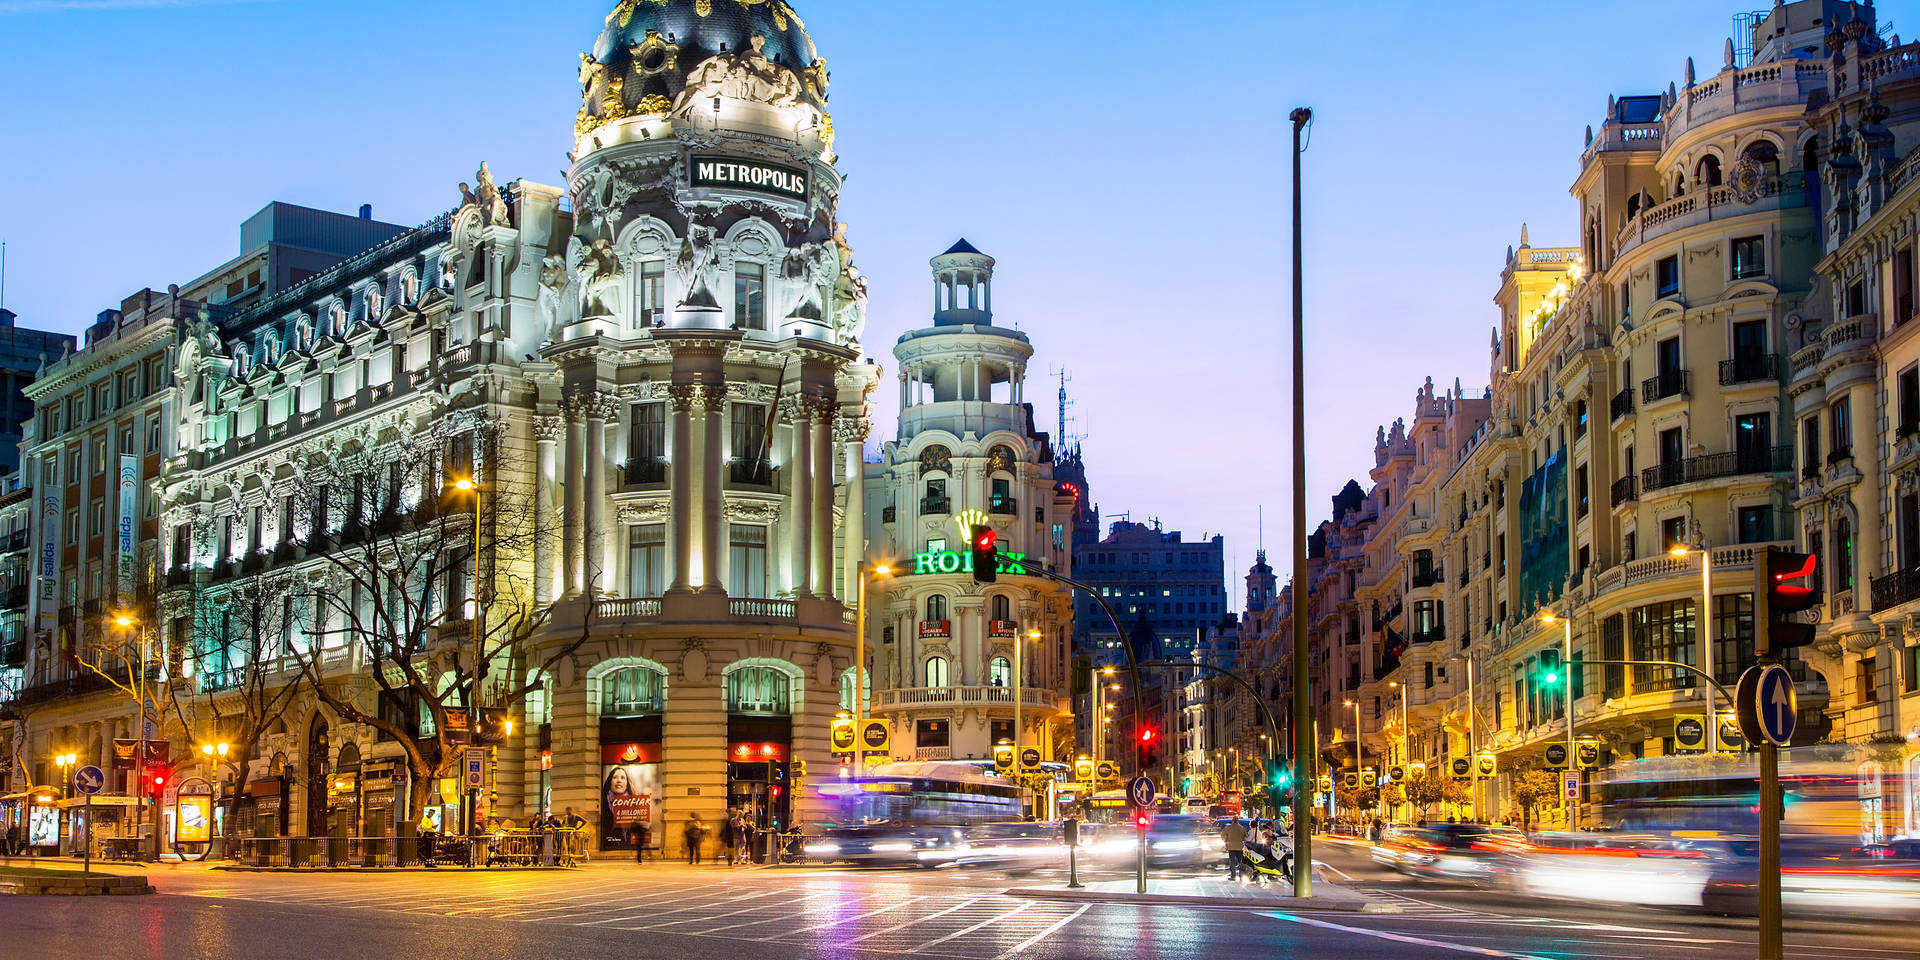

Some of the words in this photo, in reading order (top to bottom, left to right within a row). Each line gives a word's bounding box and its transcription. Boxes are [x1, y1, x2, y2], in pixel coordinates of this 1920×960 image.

[698, 162, 805, 194] METROPOLIS
[119, 516, 131, 553] salida
[42, 542, 55, 577] salida
[119, 554, 134, 579] hay
[41, 578, 56, 601] hay
[612, 797, 651, 807] CONFIAR
[620, 808, 648, 816] MILLONES
